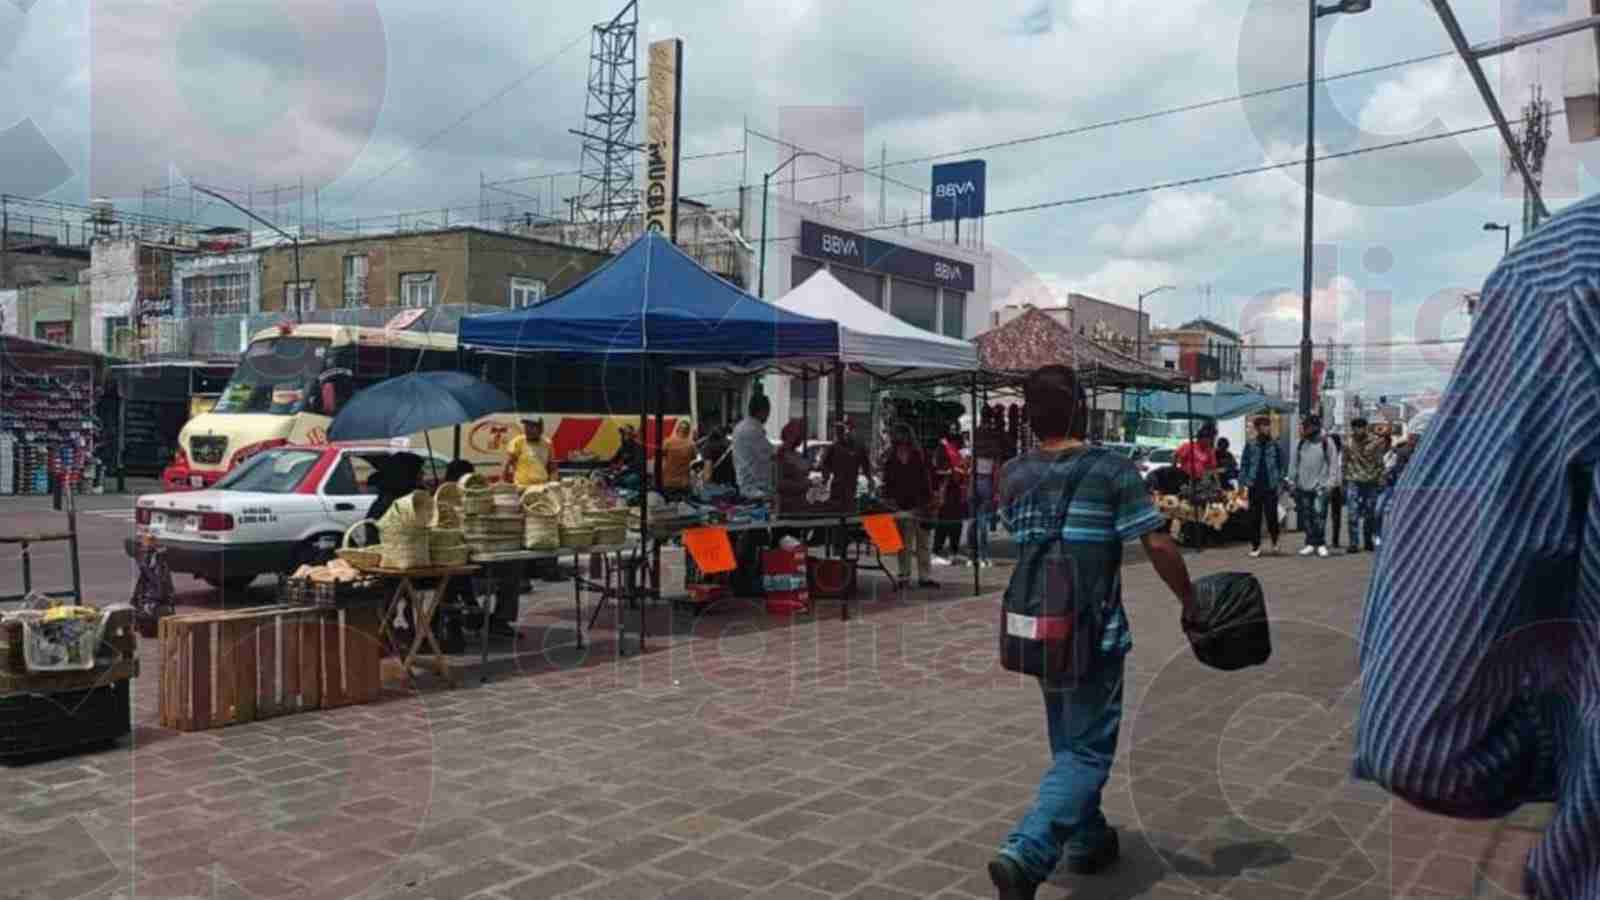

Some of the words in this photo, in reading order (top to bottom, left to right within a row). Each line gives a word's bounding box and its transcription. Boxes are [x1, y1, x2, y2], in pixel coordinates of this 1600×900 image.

[935, 181, 976, 198] BBVA
[822, 234, 859, 256] BBVA
[934, 262, 963, 280] BBVA
